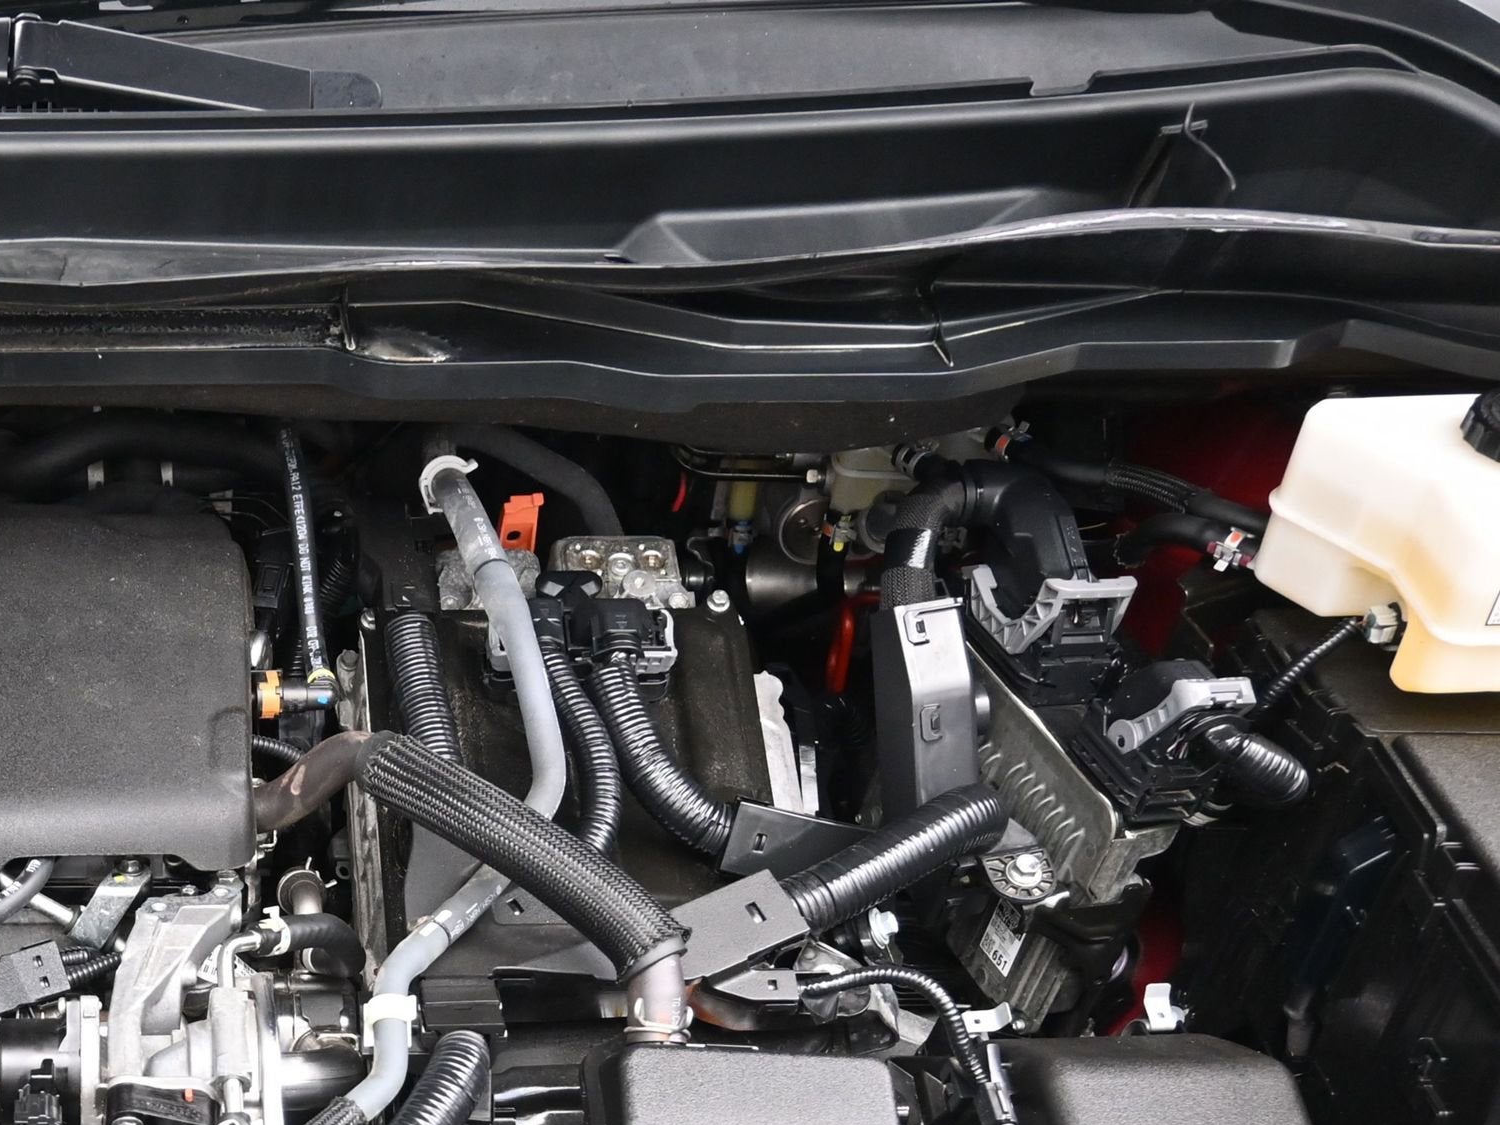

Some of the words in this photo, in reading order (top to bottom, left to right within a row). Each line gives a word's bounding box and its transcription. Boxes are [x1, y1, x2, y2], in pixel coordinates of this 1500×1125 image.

[300, 557, 311, 571] NOT
[301, 575, 313, 595] KINK
[991, 950, 1008, 971] 651
